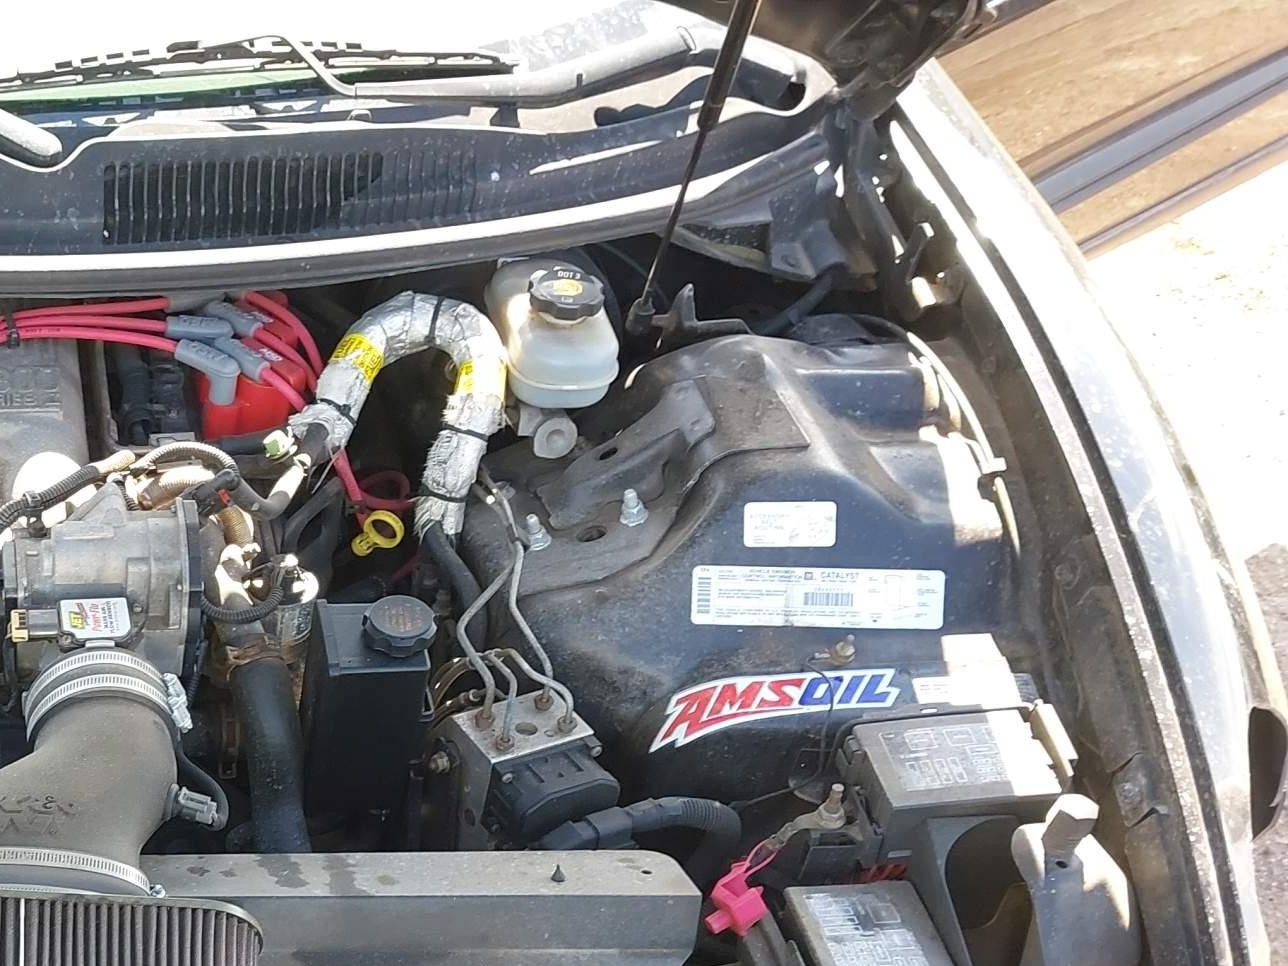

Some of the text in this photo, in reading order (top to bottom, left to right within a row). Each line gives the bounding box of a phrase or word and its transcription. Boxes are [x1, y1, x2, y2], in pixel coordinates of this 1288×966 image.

[557, 270, 573, 279] DOT
[820, 571, 860, 580] CATALYST
[662, 673, 890, 741] AMSOIL
